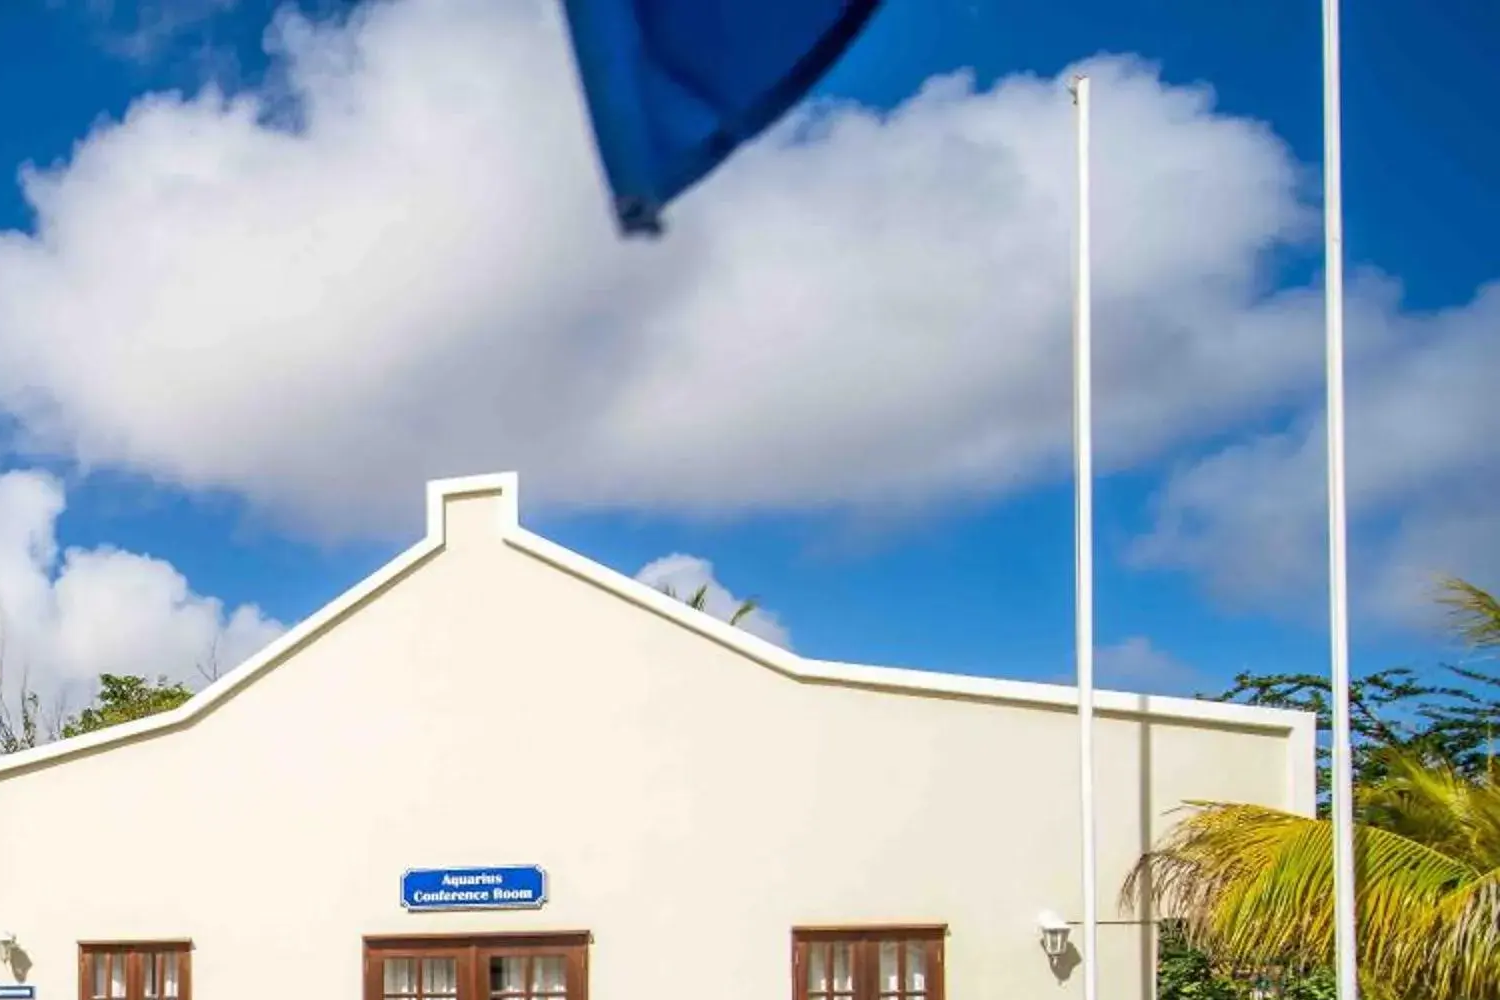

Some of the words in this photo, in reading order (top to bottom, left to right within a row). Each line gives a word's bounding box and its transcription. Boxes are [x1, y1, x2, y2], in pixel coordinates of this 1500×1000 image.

[442, 873, 503, 888] Aquarius
[413, 890, 489, 903] Conference
[493, 887, 533, 900] Room
